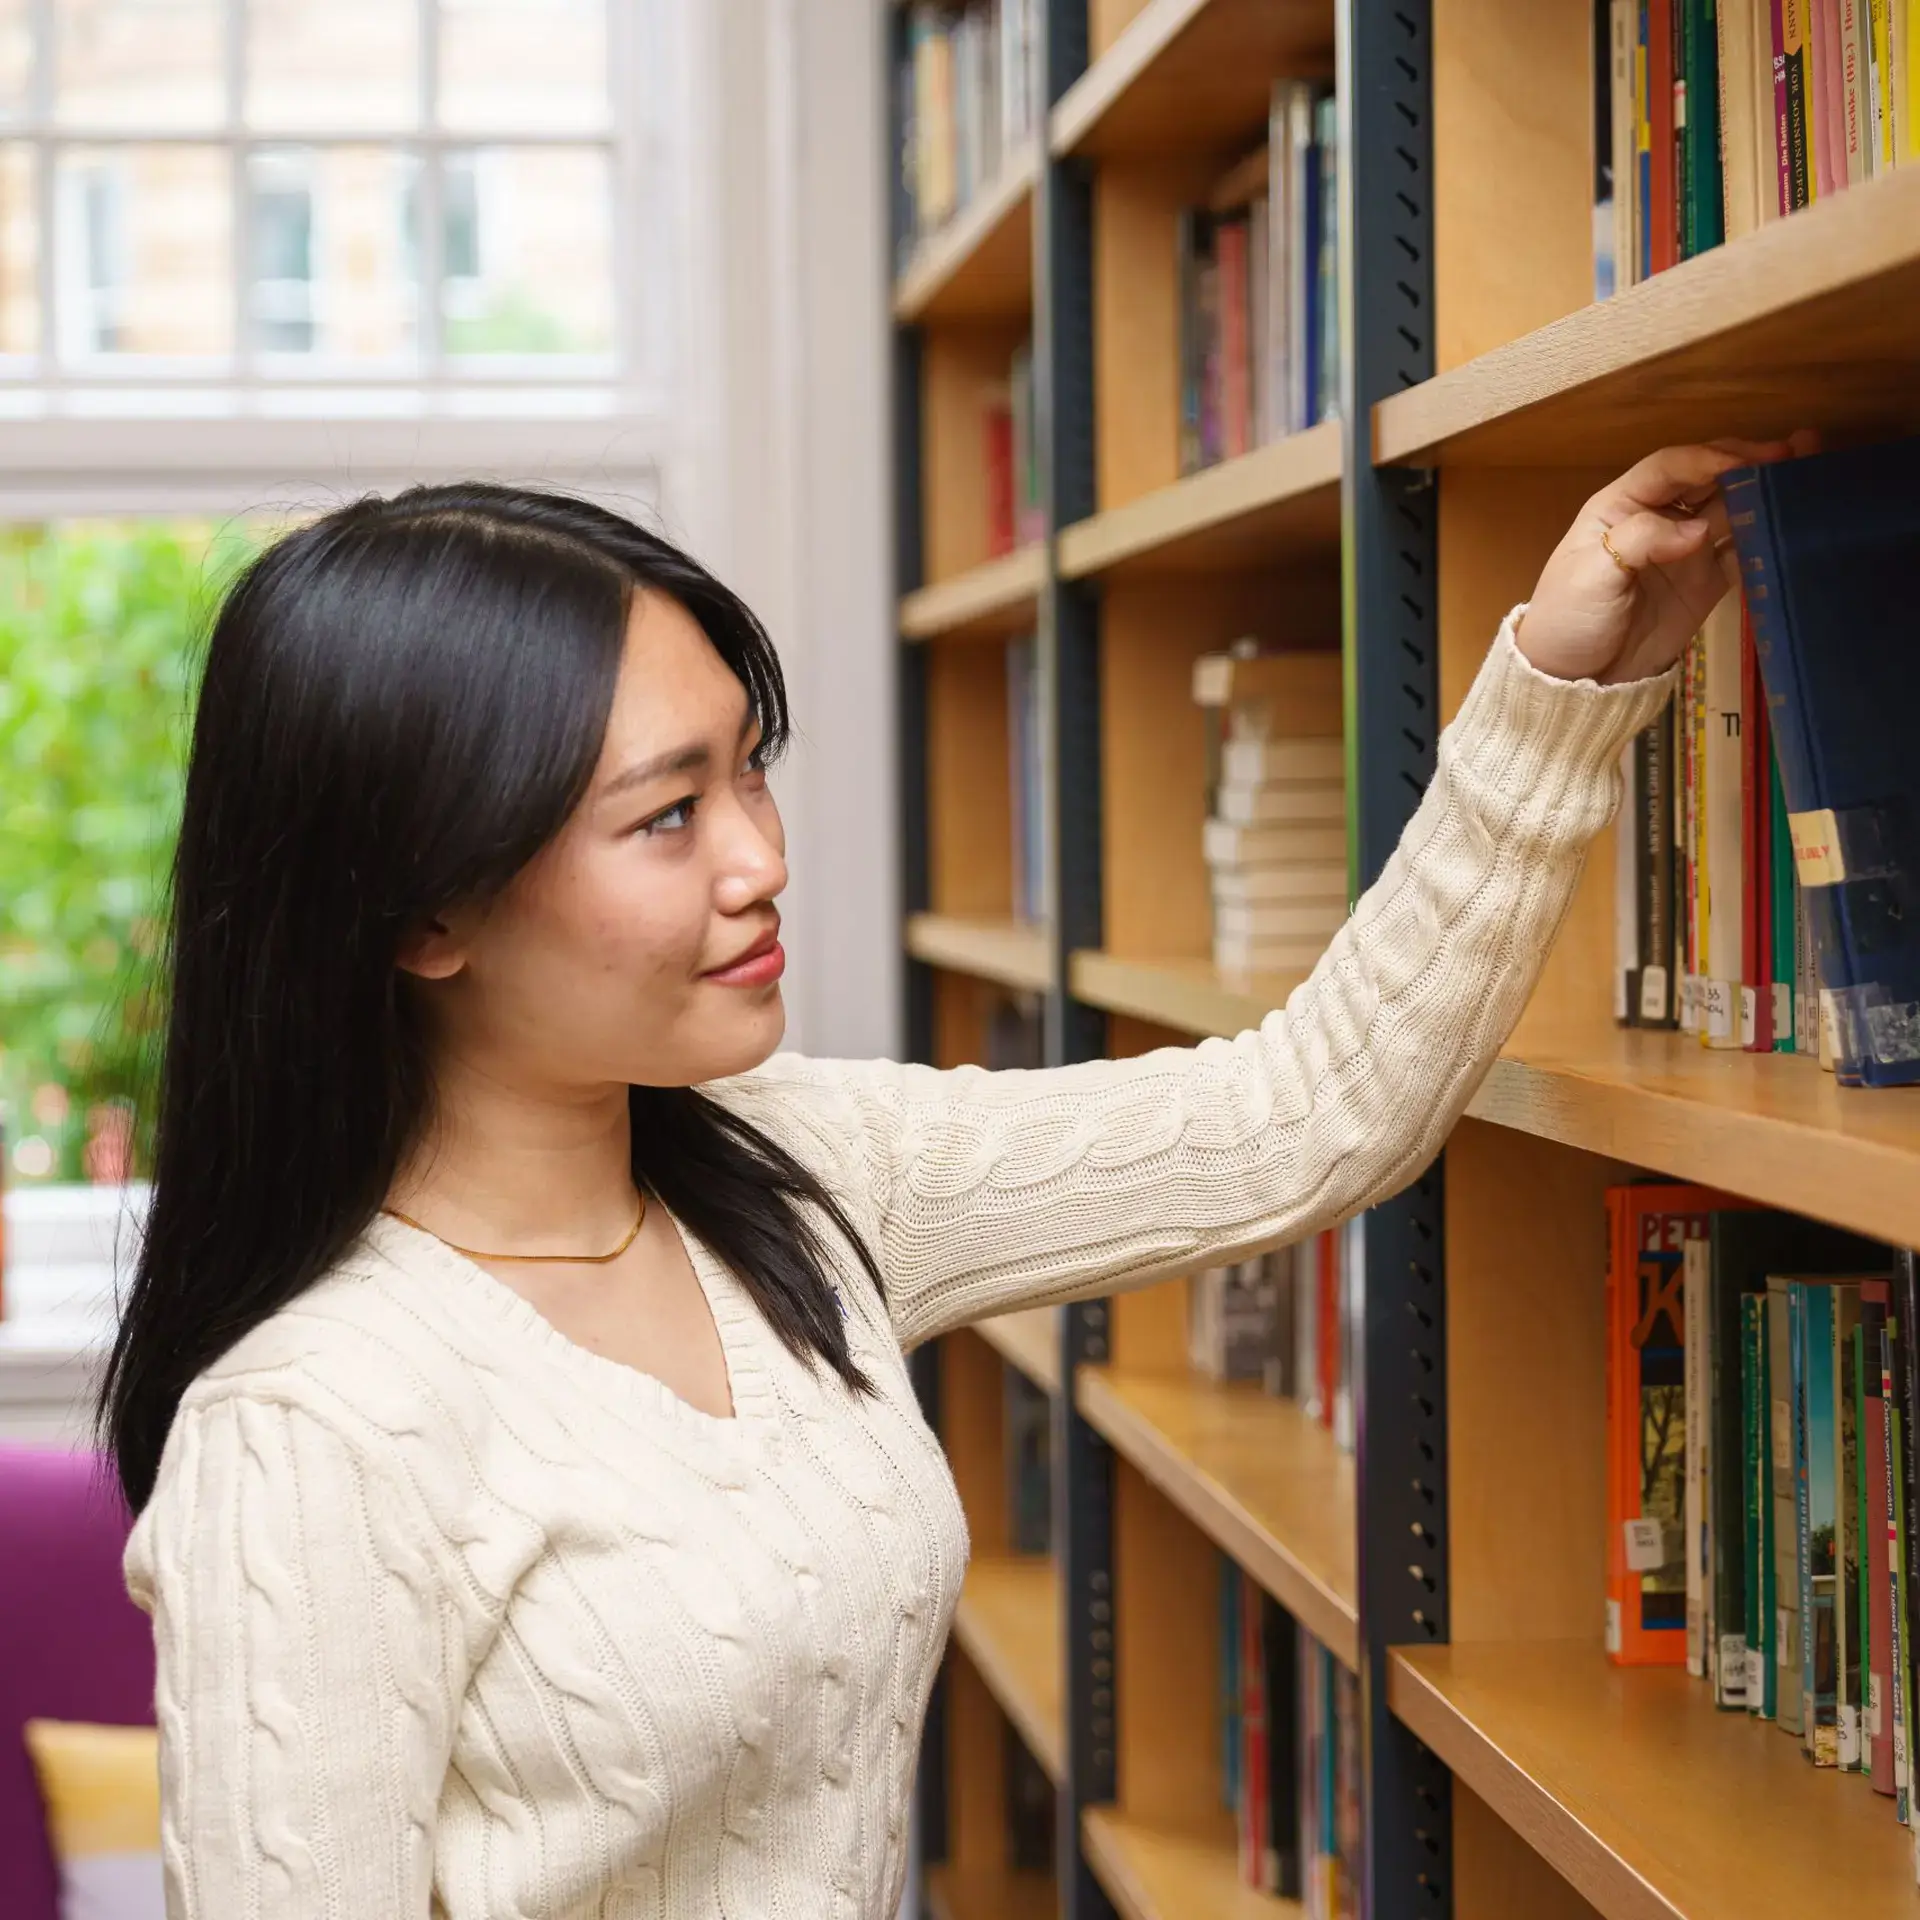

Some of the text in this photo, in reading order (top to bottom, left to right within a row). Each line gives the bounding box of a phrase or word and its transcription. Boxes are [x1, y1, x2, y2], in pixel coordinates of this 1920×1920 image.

[1791, 64, 1799, 95] VOR
[1780, 114, 1788, 146] Ratten
[1847, 88, 1858, 154] Krischke
